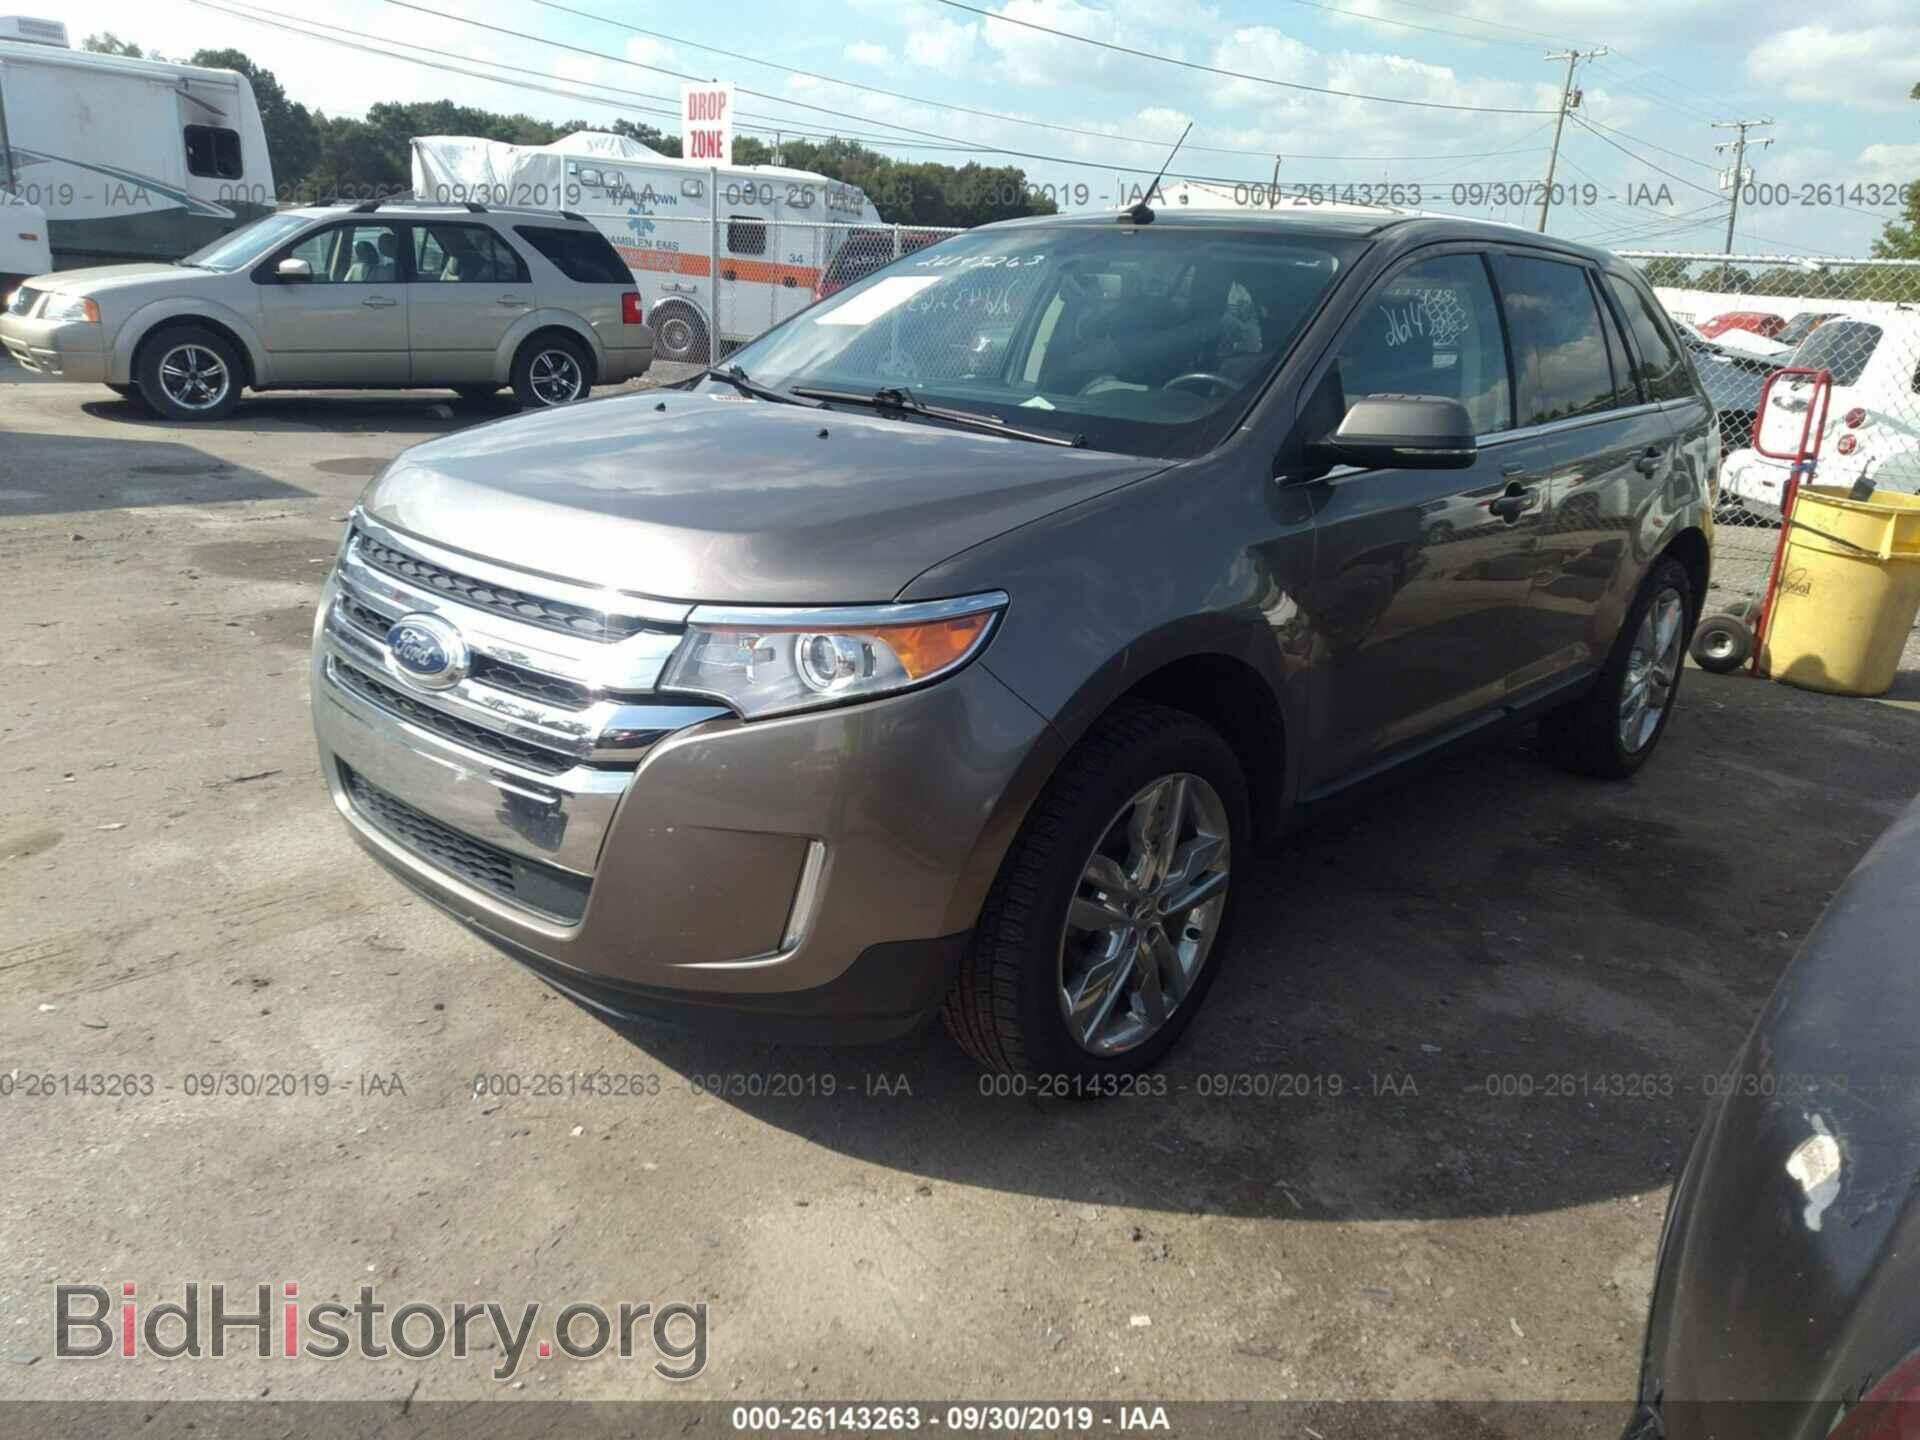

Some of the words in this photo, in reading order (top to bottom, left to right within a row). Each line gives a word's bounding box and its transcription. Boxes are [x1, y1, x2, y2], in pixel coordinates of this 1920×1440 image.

[688, 91, 727, 120] DROP
[690, 131, 724, 158] ZONE
[789, 253, 804, 264] 34
[396, 628, 435, 666] Ford
